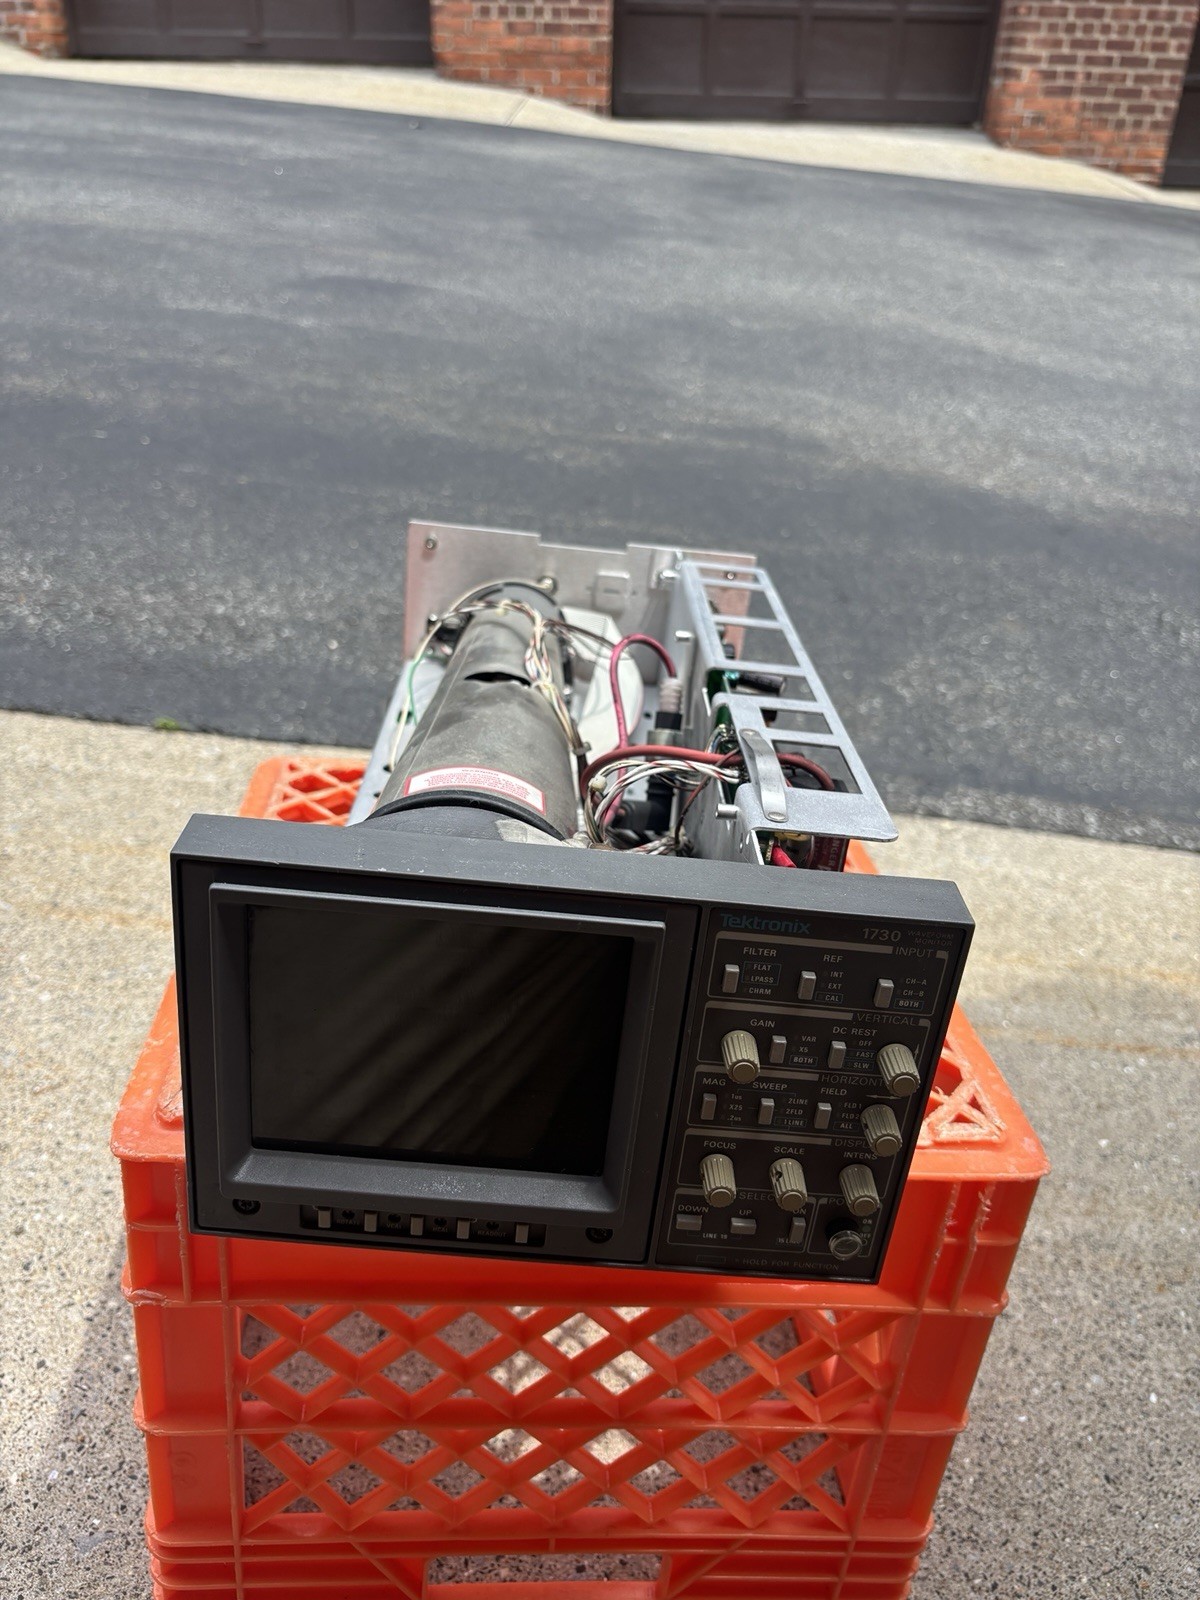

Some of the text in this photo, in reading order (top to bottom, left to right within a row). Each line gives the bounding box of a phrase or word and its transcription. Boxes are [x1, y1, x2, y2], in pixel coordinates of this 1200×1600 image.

[720, 913, 810, 934] Tektronix
[862, 927, 901, 942] 1730
[908, 930, 954, 940] WAVEFORM
[915, 937, 953, 946] MONITOR
[743, 947, 777, 958] FILTER
[895, 946, 934, 958] INPUT
[823, 954, 844, 963] REF
[753, 963, 772, 972] FLAT
[750, 975, 774, 983] LPASS
[827, 982, 842, 990] EXT
[748, 987, 772, 995] CHRM
[902, 989, 924, 997] CH-B
[825, 994, 840, 1002] CAL
[898, 1000, 920, 1008] BOTH
[750, 1018, 776, 1028] GAIN
[857, 1013, 917, 1026] VERTICAL
[832, 1026, 878, 1037] DC REST
[801, 1035, 817, 1043] VAR
[793, 1056, 814, 1064] BOTH
[702, 1077, 726, 1087] MAG
[821, 1074, 884, 1087] HORIZONT
[752, 1081, 788, 1091] SWEEP
[820, 1087, 848, 1096] FIELD
[728, 1103, 743, 1111] X25
[785, 1108, 804, 1116] 2FLD
[703, 1140, 737, 1150] FOCUS
[834, 1138, 870, 1149] DISPL
[774, 1146, 805, 1155] SCALE
[843, 1151, 878, 1160] INTENS
[739, 1191, 774, 1201] SELEC
[677, 1204, 709, 1213] DOWN
[742, 1257, 768, 1265] HOLD
[793, 1261, 840, 1271] FUNCTION
